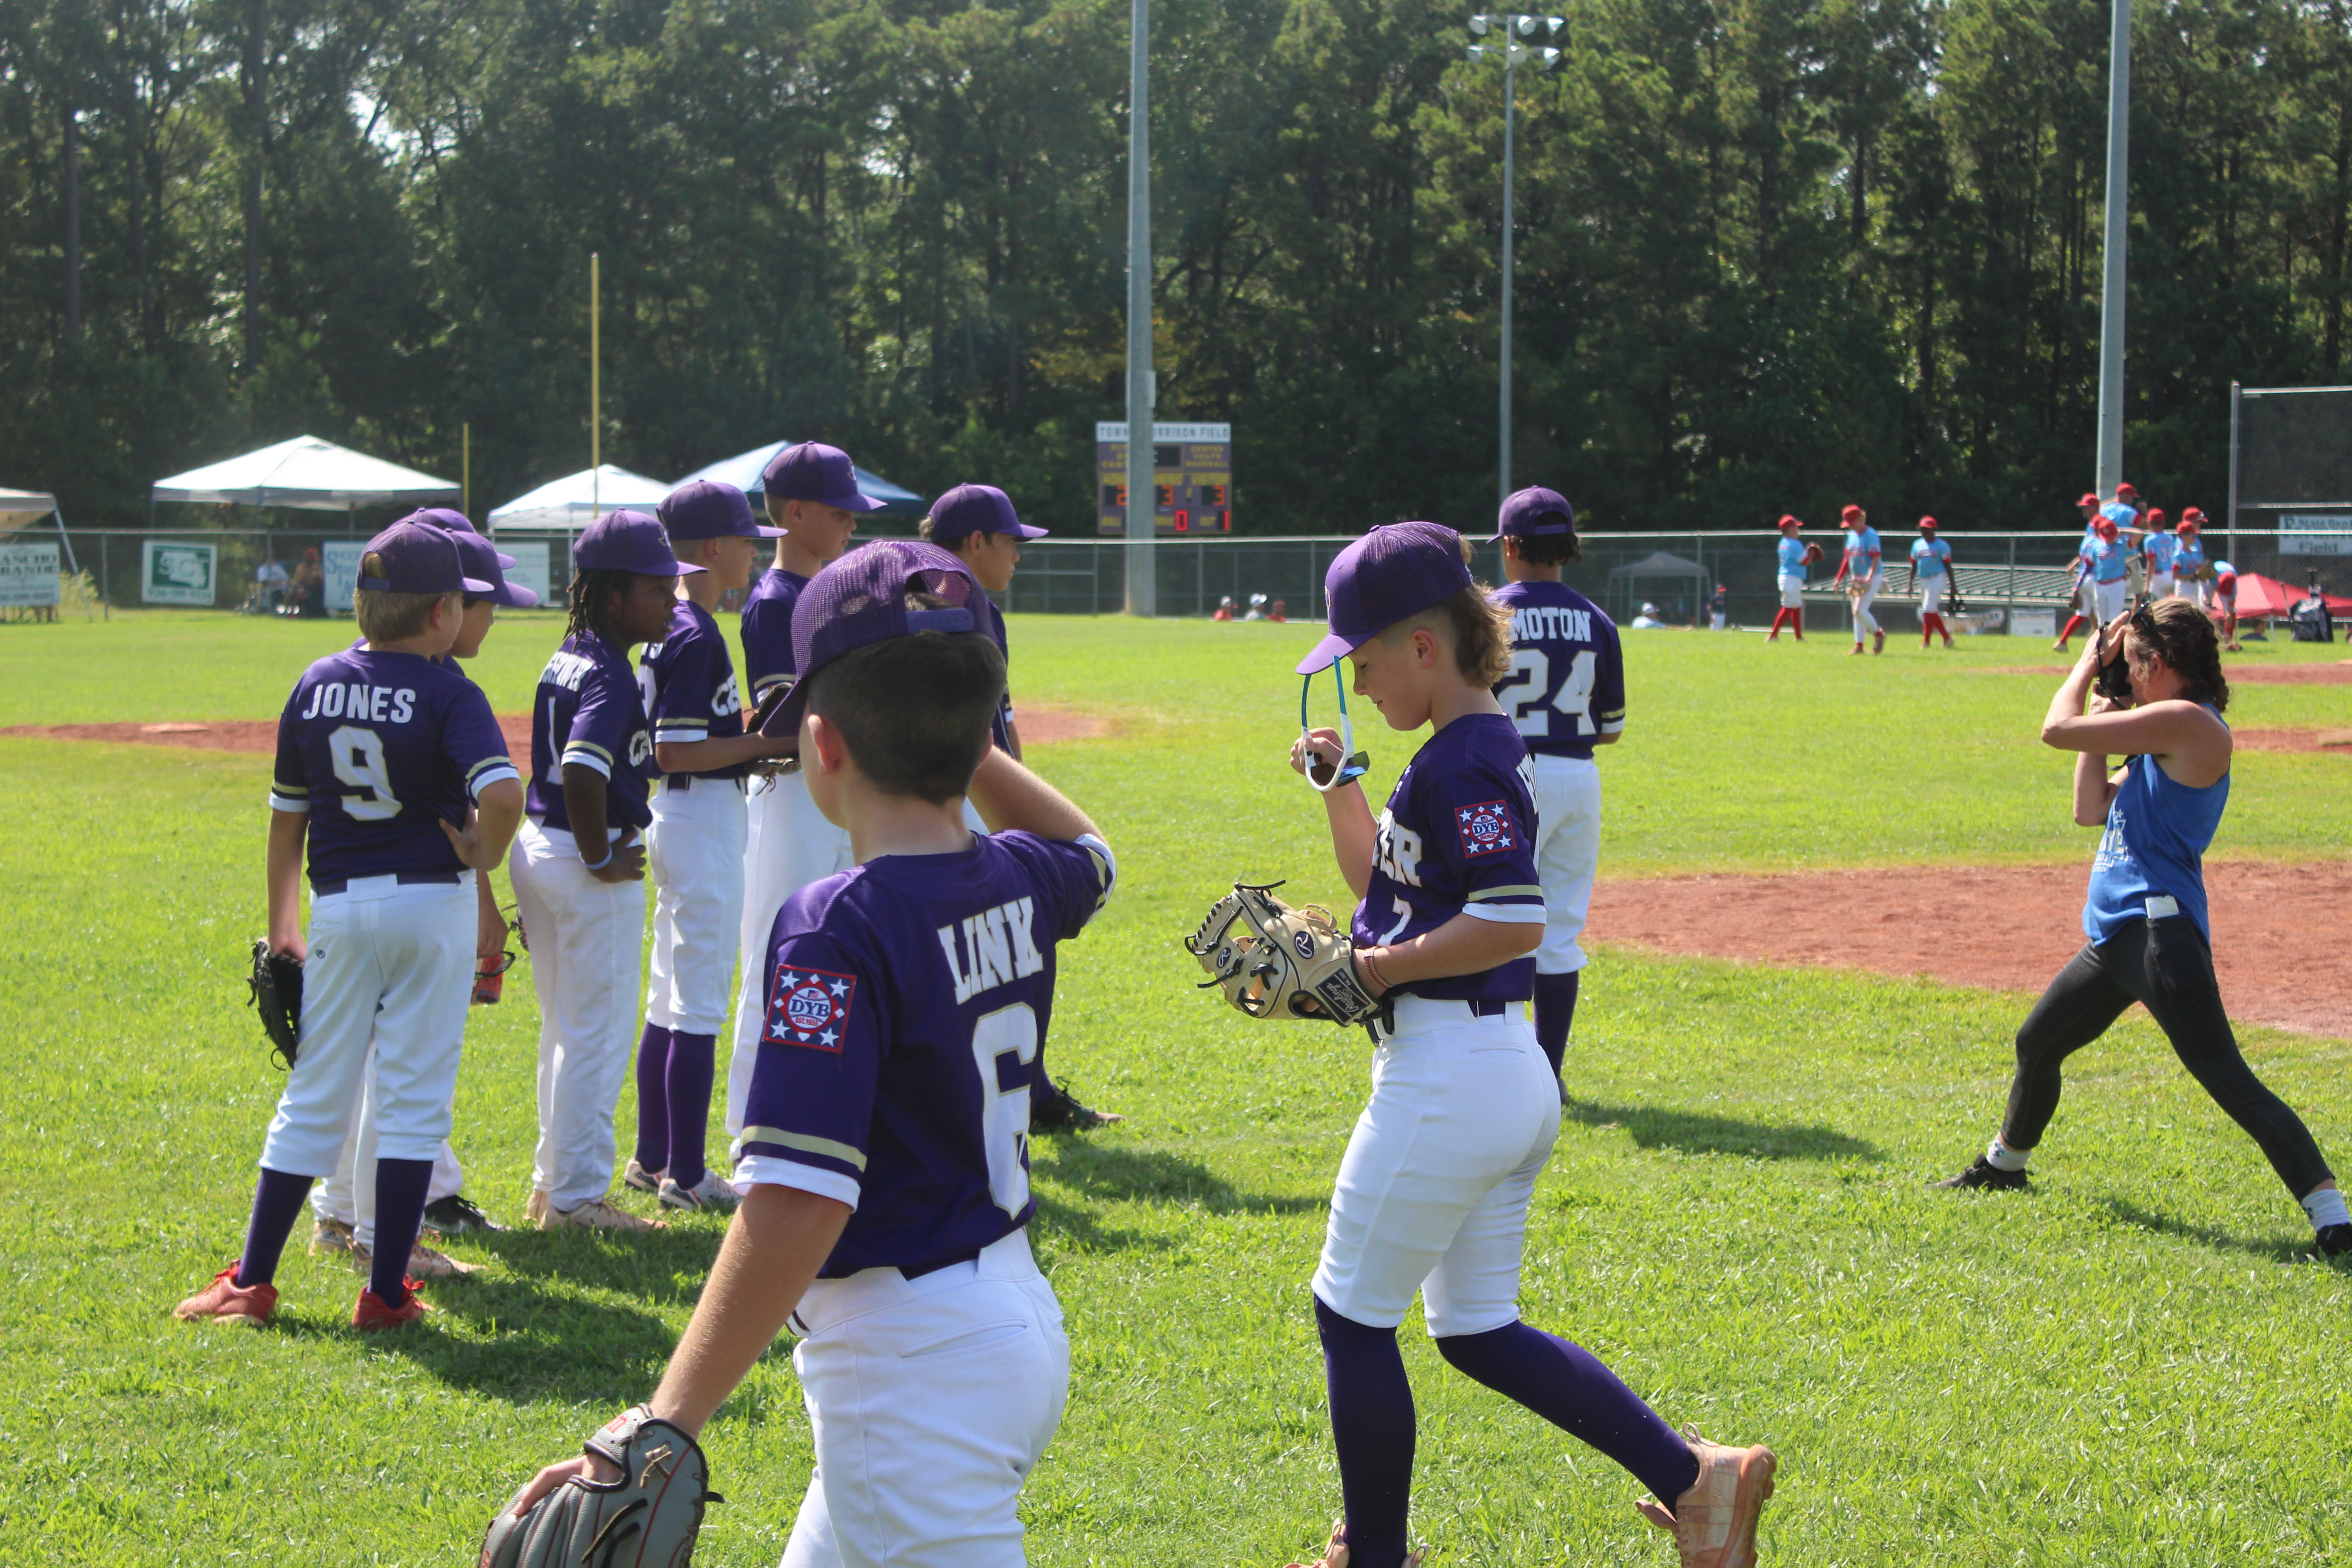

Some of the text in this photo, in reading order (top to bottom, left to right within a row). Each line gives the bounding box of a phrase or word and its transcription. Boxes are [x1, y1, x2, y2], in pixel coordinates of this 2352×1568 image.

[1200, 428, 1229, 438] FIELD
[1161, 485, 1174, 506] 3
[1213, 485, 1225, 506] 3
[1175, 510, 1189, 531] 0
[2299, 542, 2338, 553] Field
[2, 554, 57, 565] ANCHO
[0, 566, 54, 576] RANDE
[1509, 606, 1592, 642] MOTON
[302, 682, 416, 724] JONES
[1498, 648, 1598, 737] 24
[328, 725, 404, 822] 9
[1473, 822, 1499, 834] DYB
[1376, 894, 1413, 947] 7
[937, 896, 1044, 1005] LINK
[789, 999, 830, 1017] DYB
[1326, 982, 1359, 1013] Rawlings
[971, 1001, 1038, 1221] 6
